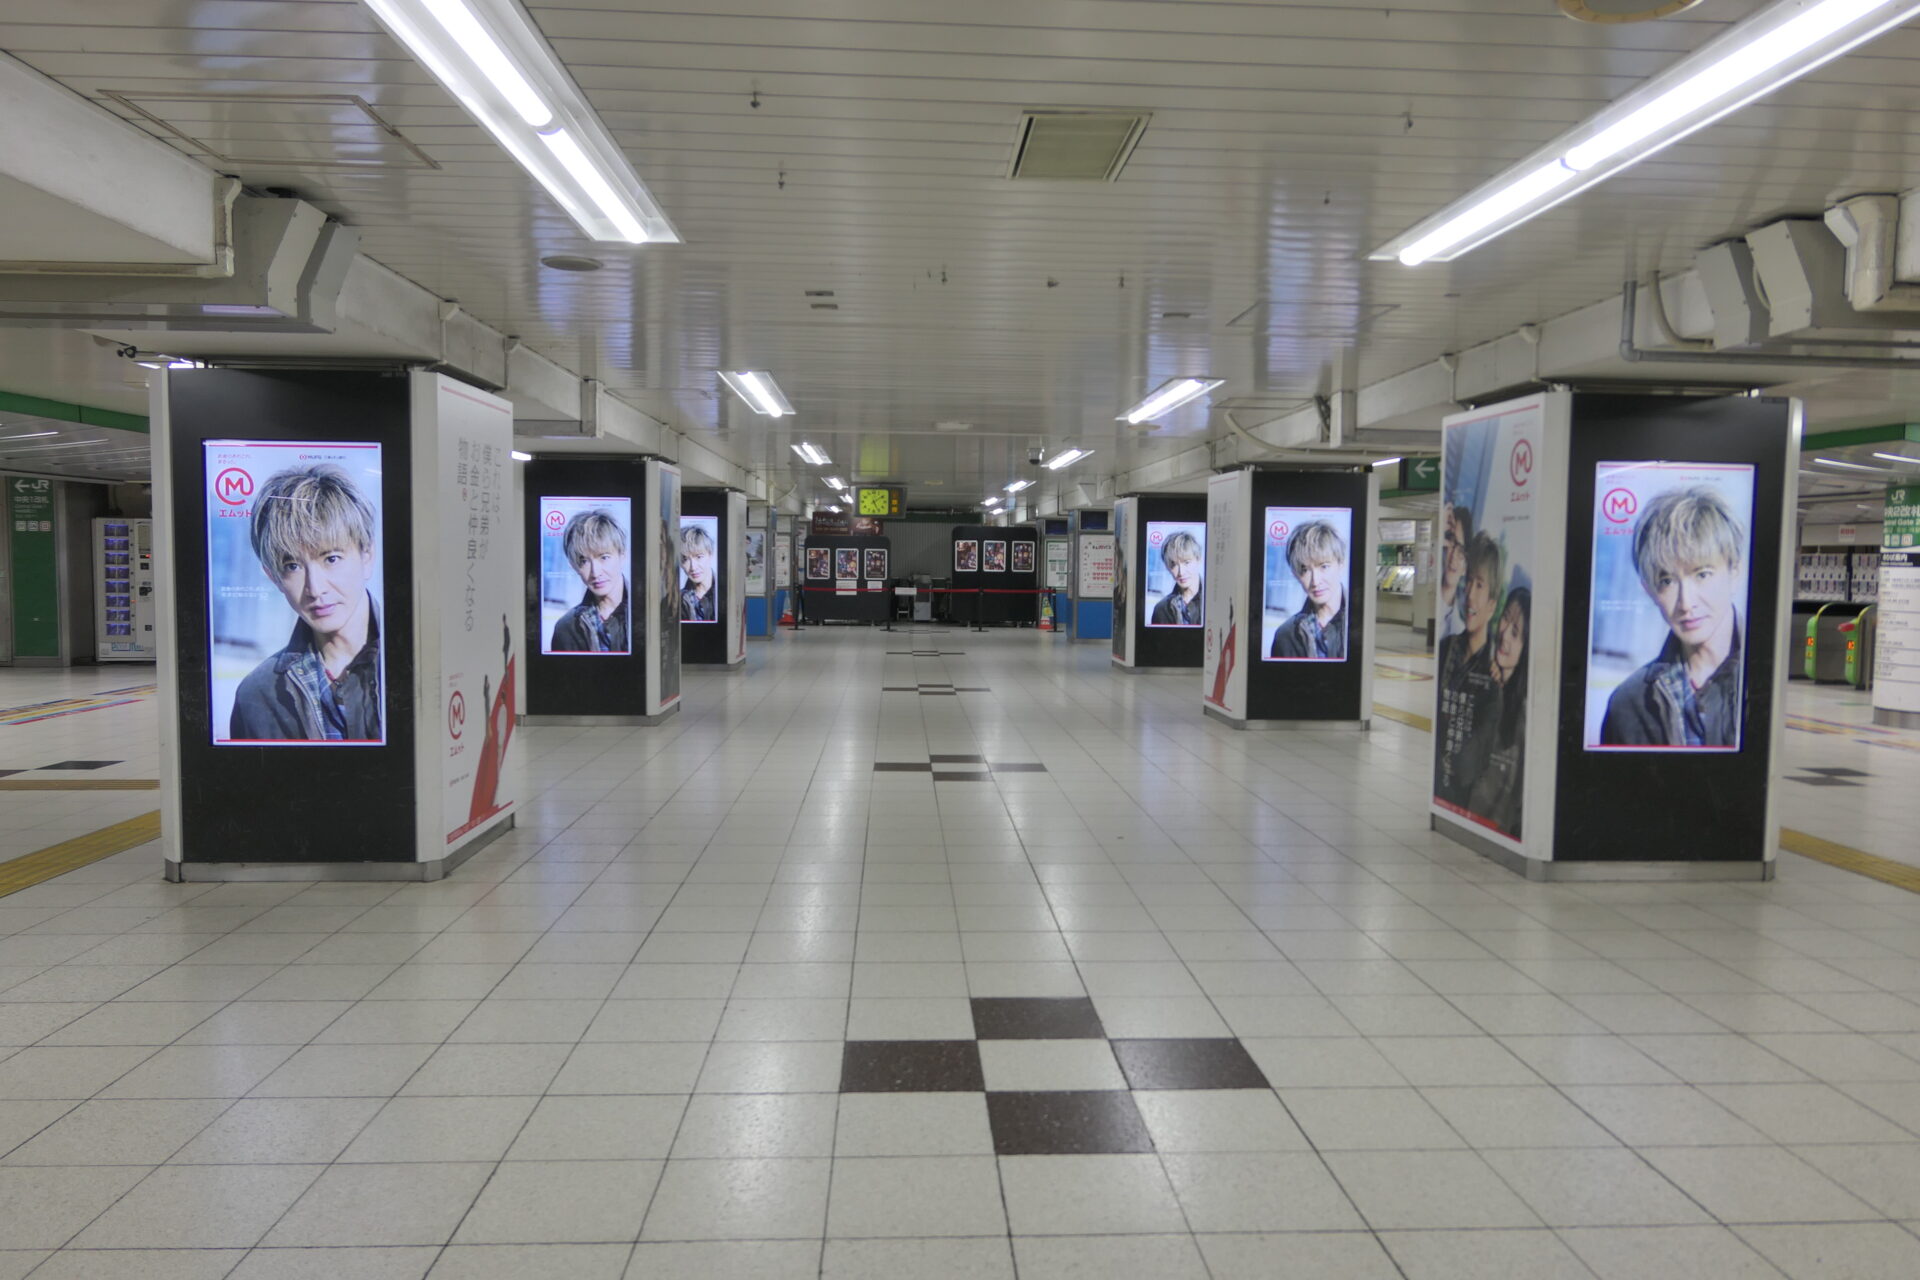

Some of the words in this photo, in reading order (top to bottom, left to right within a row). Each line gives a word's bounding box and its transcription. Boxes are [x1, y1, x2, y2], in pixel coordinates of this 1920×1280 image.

[31, 479, 49, 490] JR
[1891, 490, 1905, 501] JR
[219, 509, 253, 518] エムット
